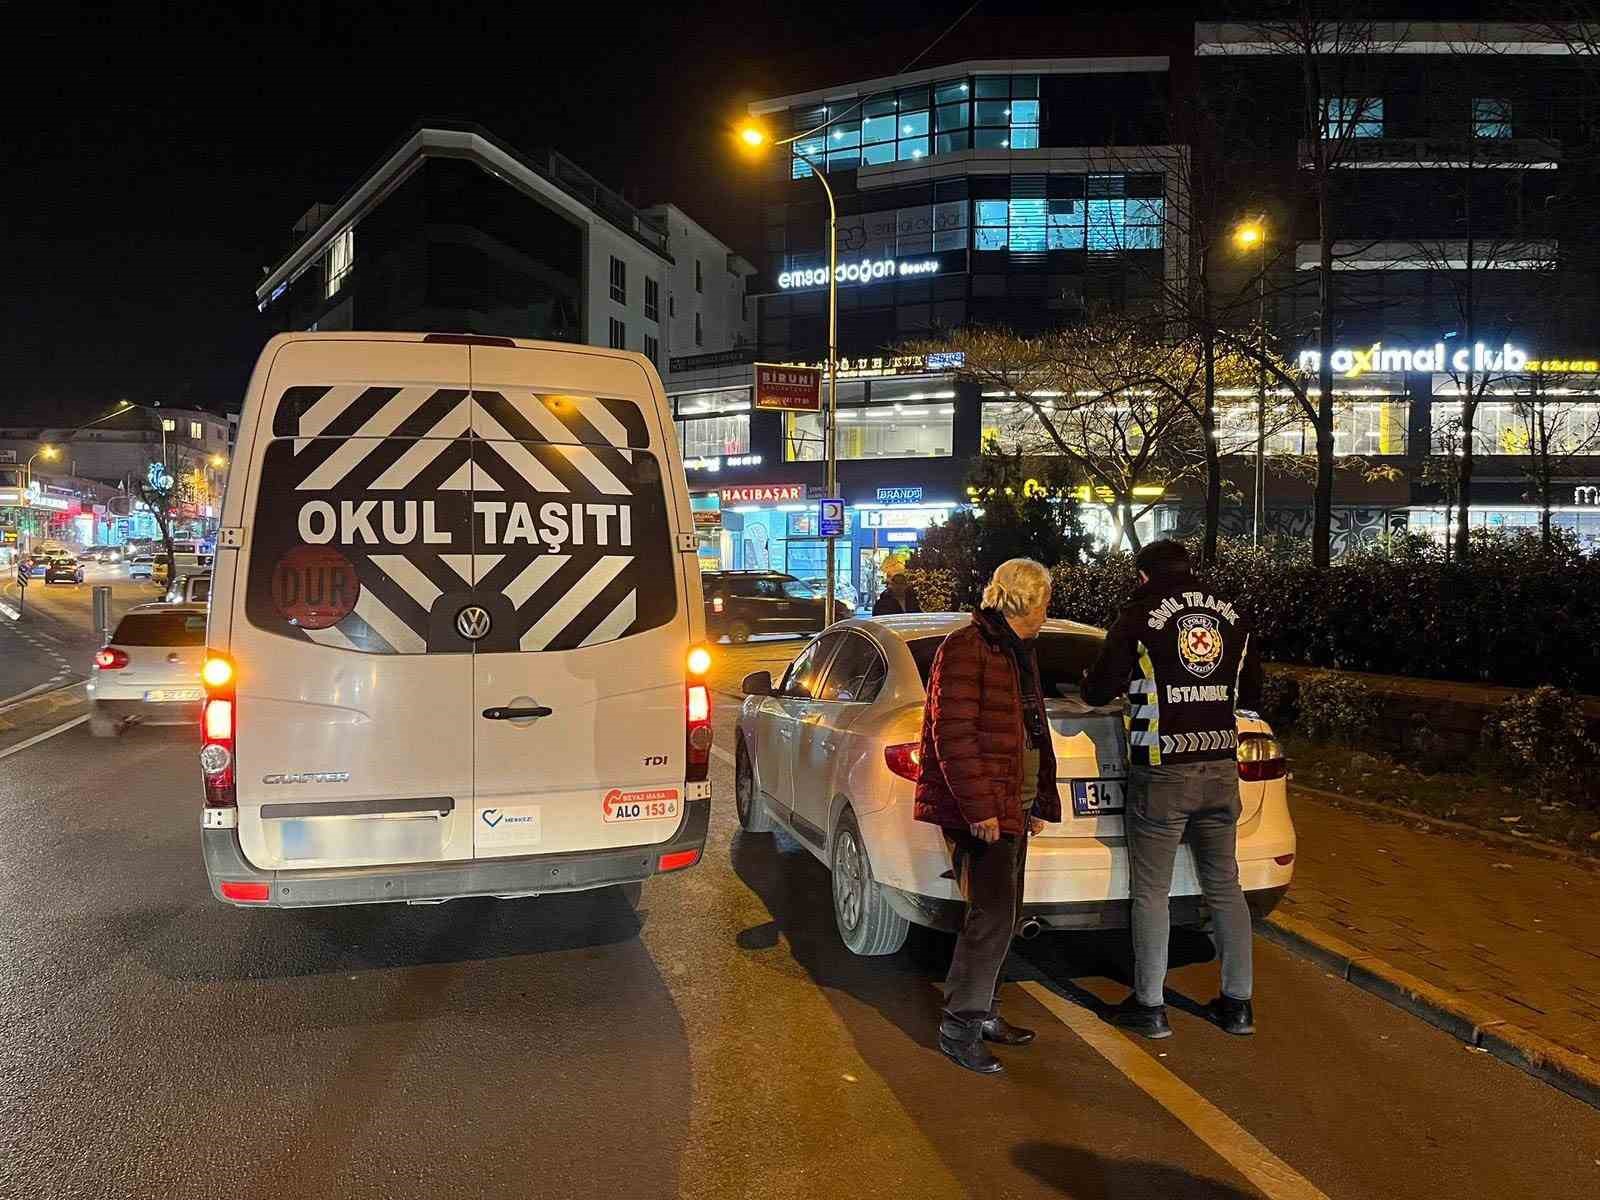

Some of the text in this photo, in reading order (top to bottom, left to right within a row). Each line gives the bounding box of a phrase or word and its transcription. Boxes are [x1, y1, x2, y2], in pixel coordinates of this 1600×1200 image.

[297, 499, 632, 553] OKUL TAŞITI
[643, 756, 668, 766] TDI
[1088, 784, 1111, 806] 34
[616, 803, 666, 818] ALO 153
